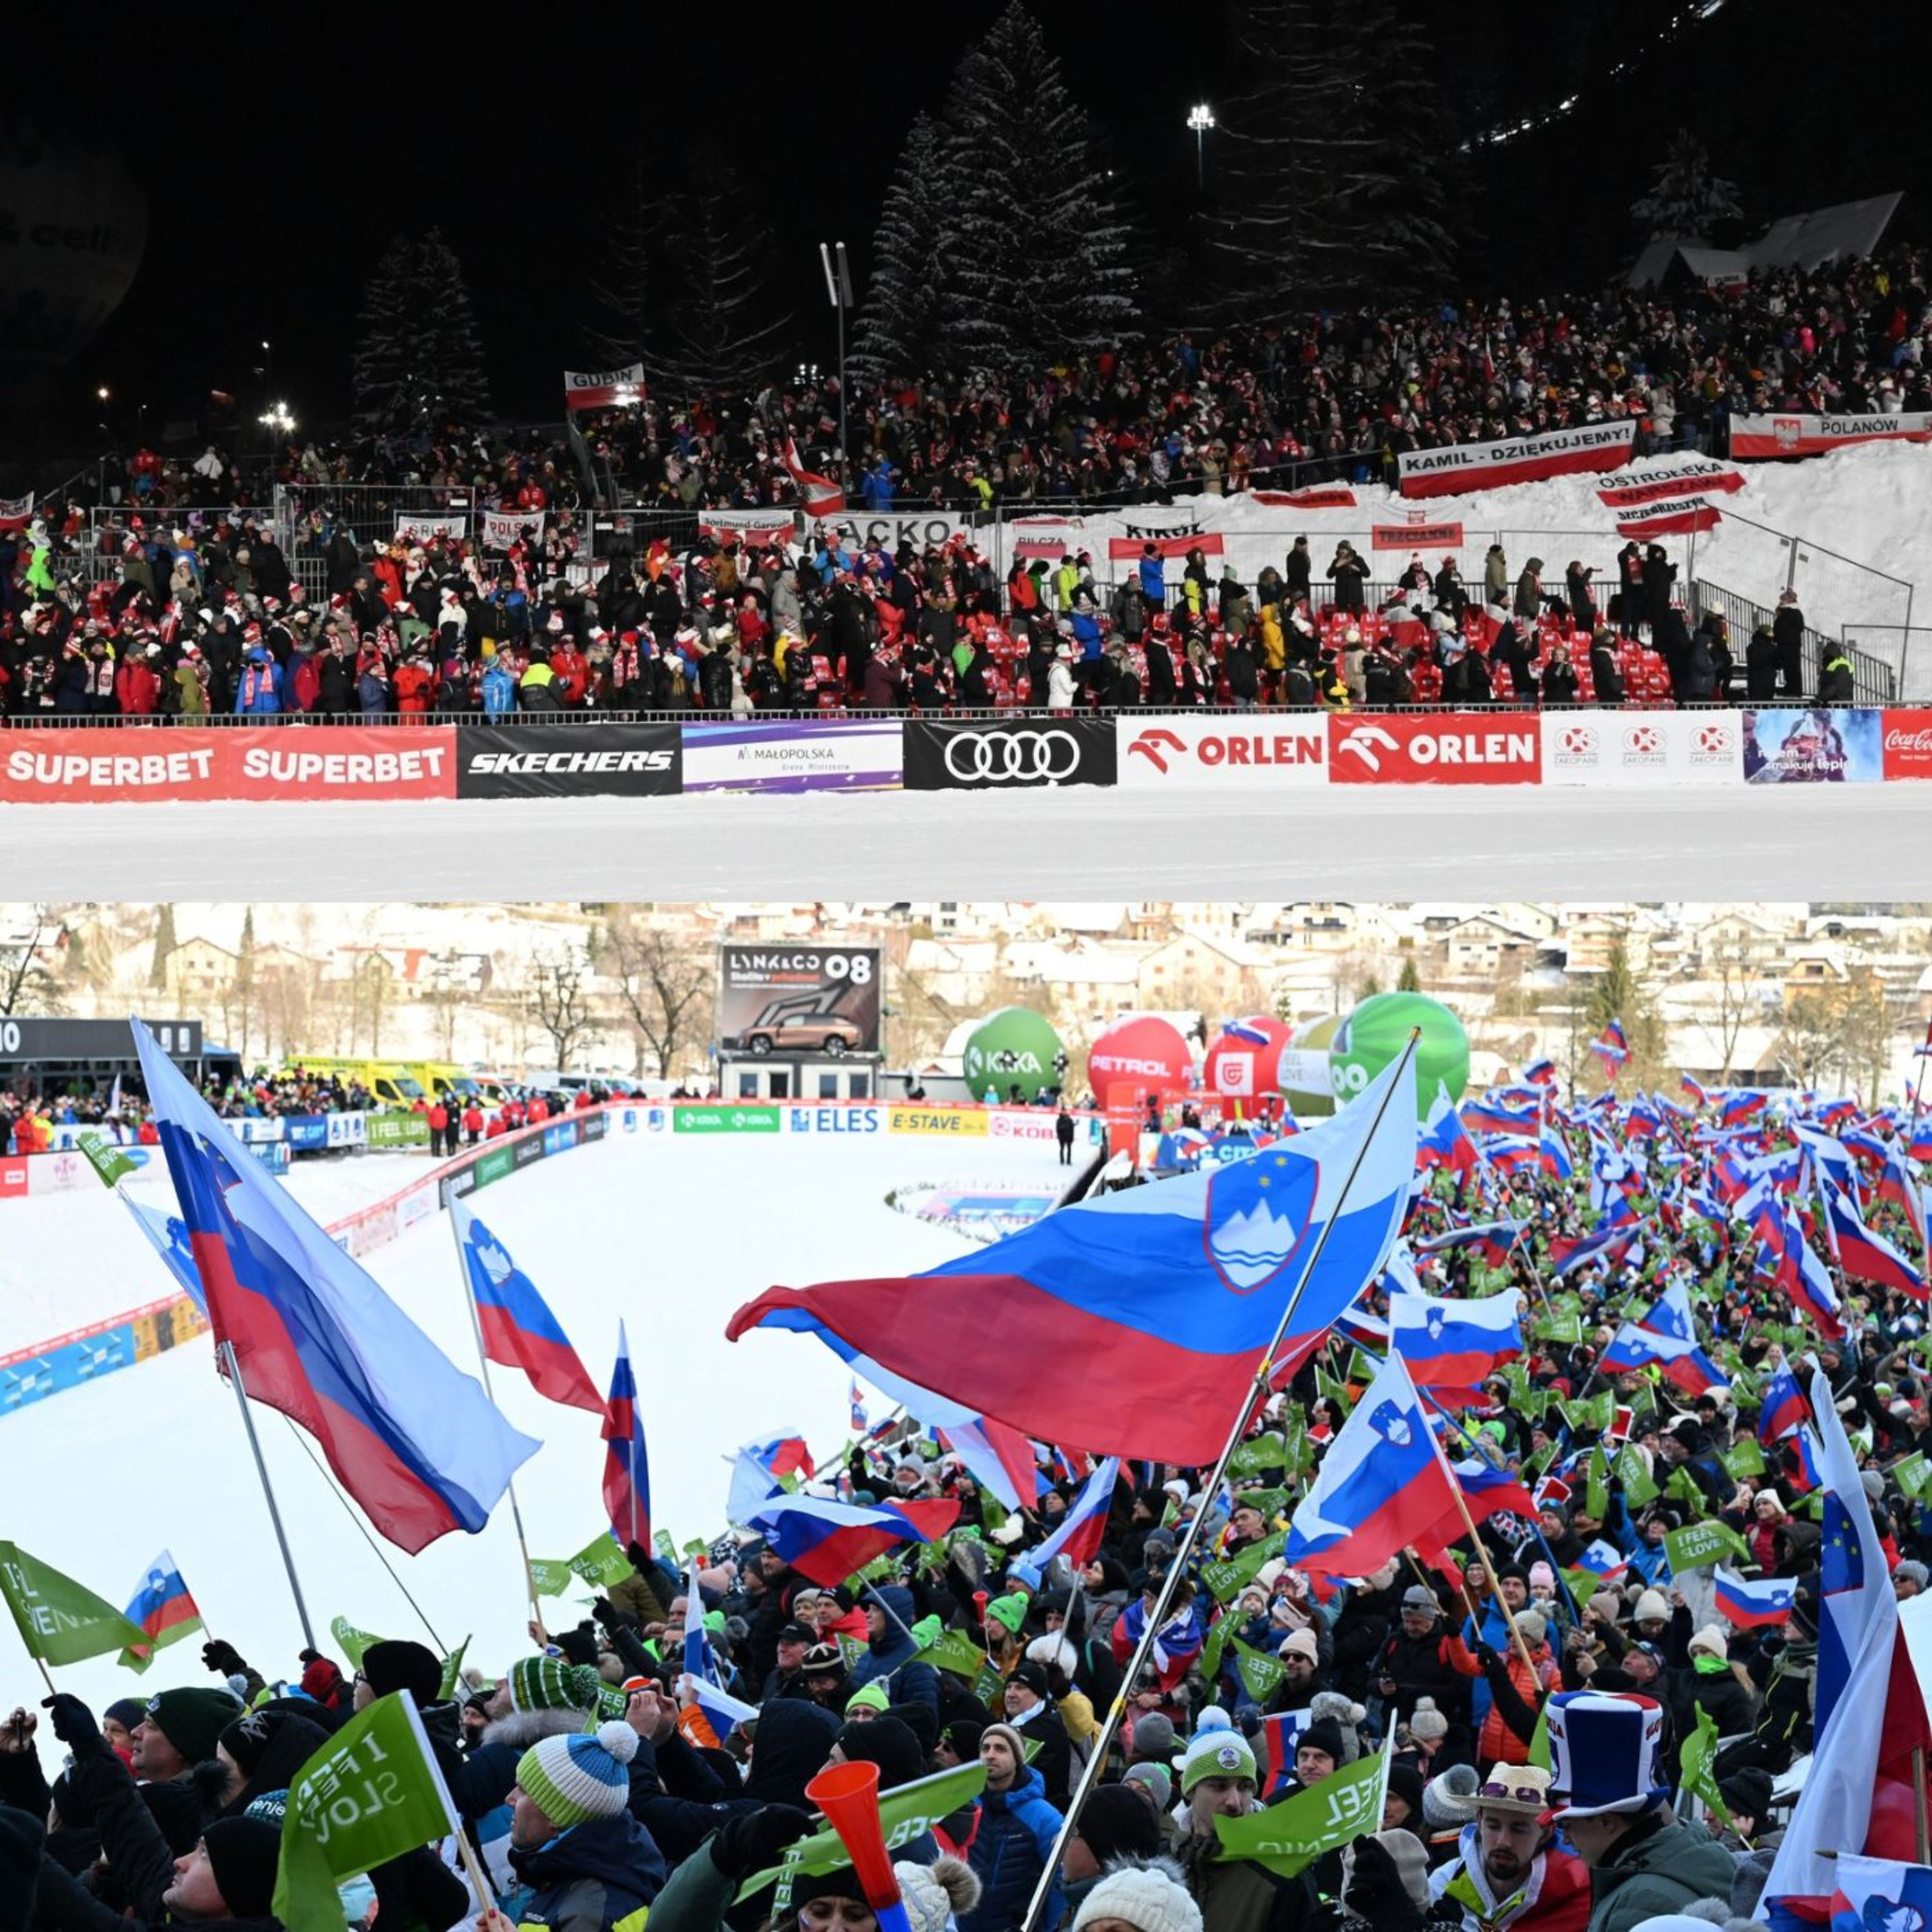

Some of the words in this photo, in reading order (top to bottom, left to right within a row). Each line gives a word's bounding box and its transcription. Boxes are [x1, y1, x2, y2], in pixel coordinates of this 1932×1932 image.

[574, 370, 632, 387] GUBIN
[1821, 419, 1898, 434] POLANÓW
[1406, 452, 1473, 471] KAMIL
[1492, 428, 1630, 461] DZIĘKUJEMY!
[1599, 462, 1723, 488] OSTROŁĘKA
[490, 522, 540, 536] POLSA
[840, 520, 951, 549] ĄCKO
[1197, 736, 1321, 766] ORLEN
[1408, 734, 1535, 764] ORLEN
[1885, 728, 1932, 751] Coca-Co
[243, 748, 445, 783] SUPERBET
[468, 750, 674, 773] SKECHERS
[754, 748, 834, 761] MAŁOPOLSKA
[7, 750, 214, 786] SUPERBET
[824, 954, 872, 985] 08
[1091, 1055, 1171, 1077] PETROL
[817, 1109, 879, 1132] ELES
[1012, 1126, 1056, 1141] KOB
